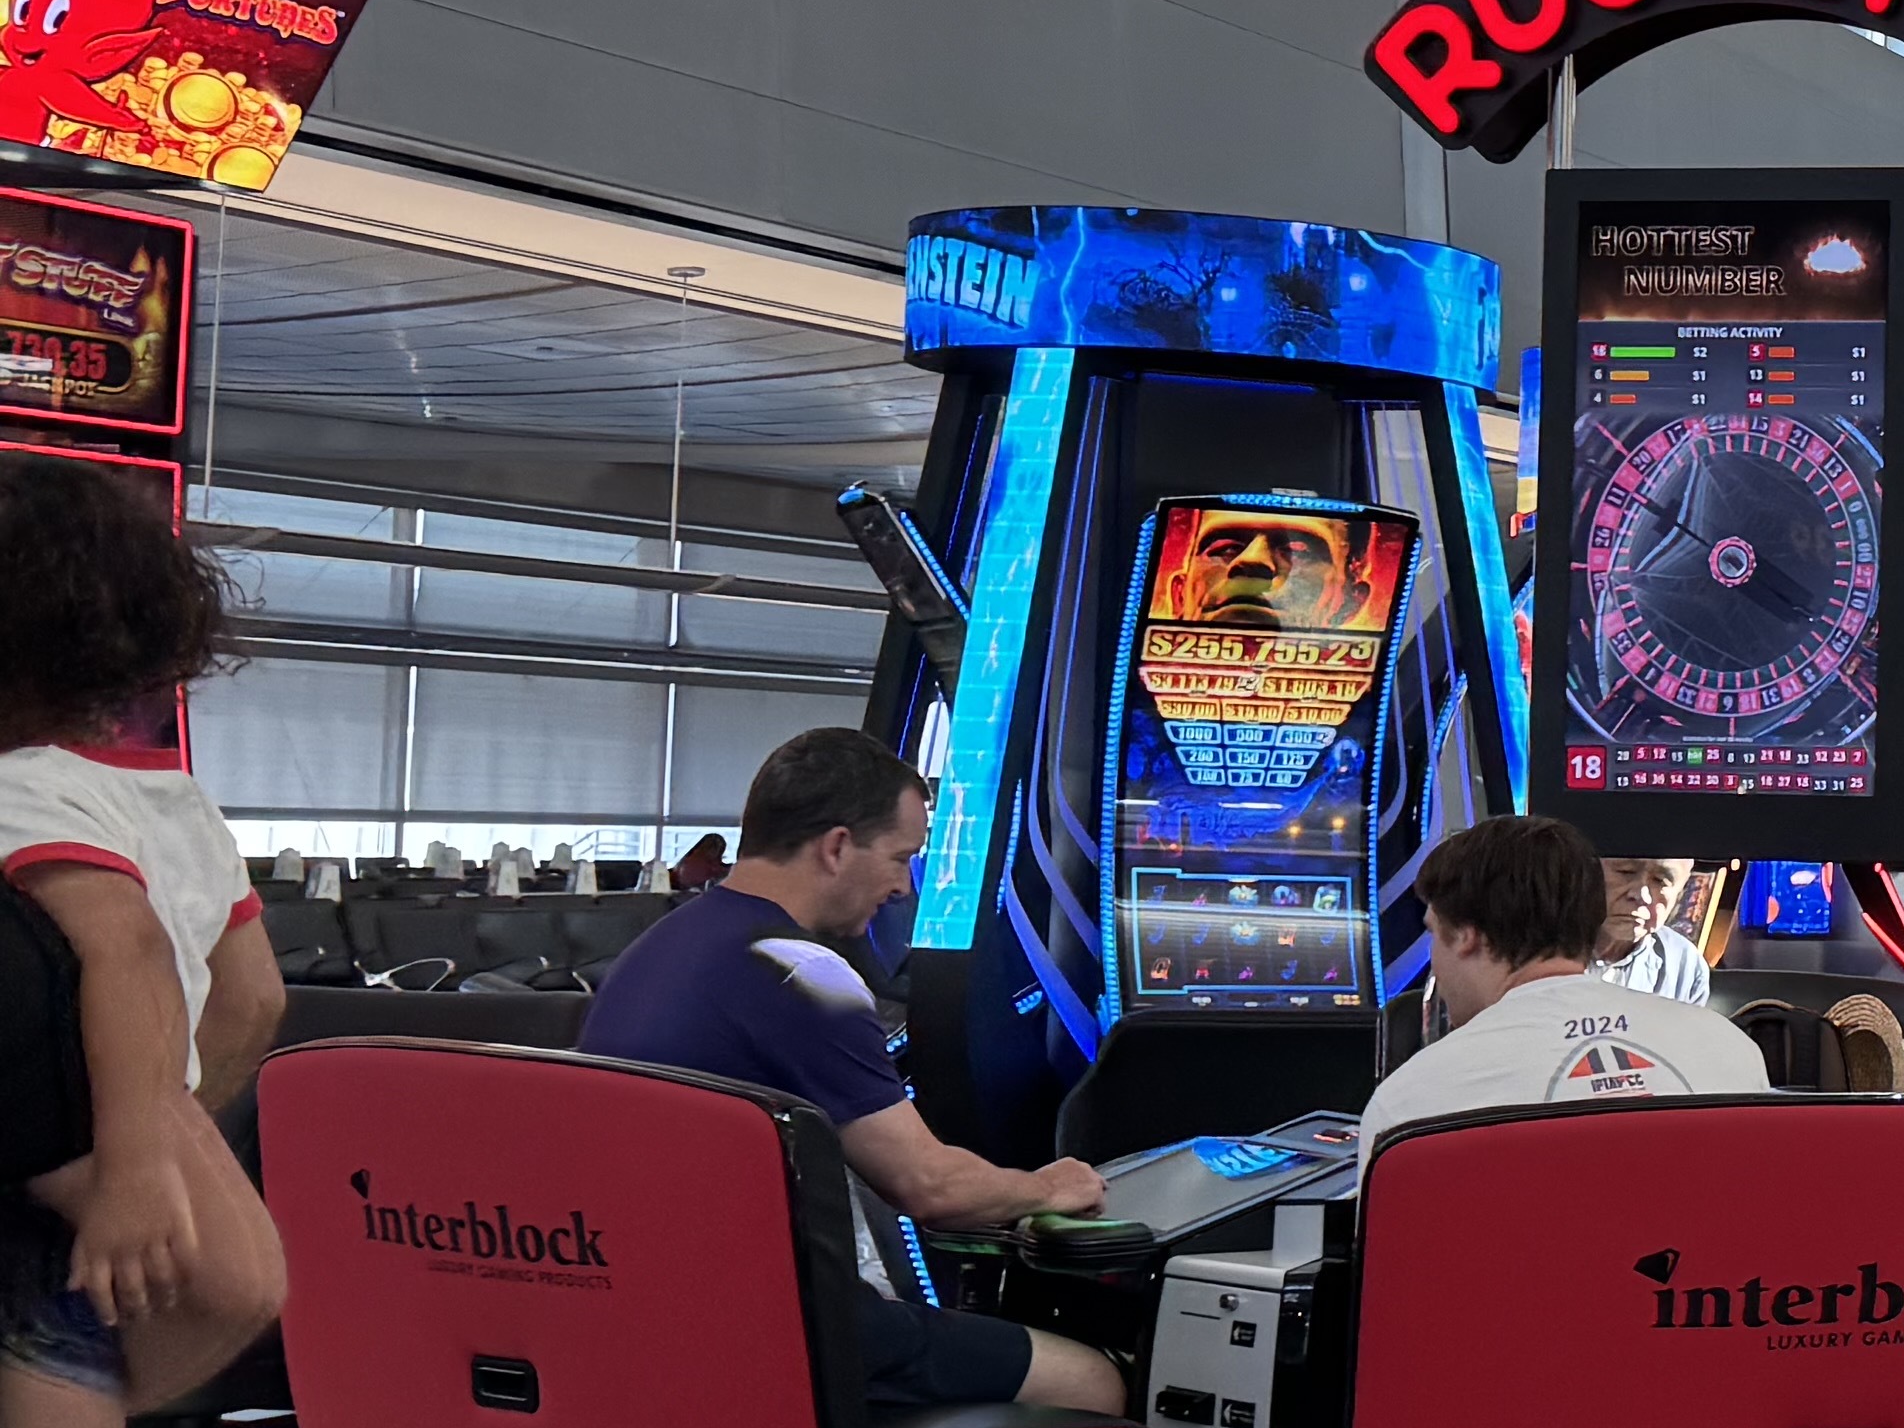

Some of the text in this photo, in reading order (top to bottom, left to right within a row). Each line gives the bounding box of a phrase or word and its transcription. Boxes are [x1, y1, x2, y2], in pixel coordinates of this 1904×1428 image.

[1591, 225, 1755, 257] HOTTEST
[1624, 264, 1787, 297] NUMBER
[1677, 326, 1783, 339] BETTING ACTIVITY
[1571, 755, 1601, 780] 18
[1564, 1014, 1629, 1040] 2024
[355, 1182, 609, 1268] interblock
[1767, 1330, 1852, 1352] LUXURY
